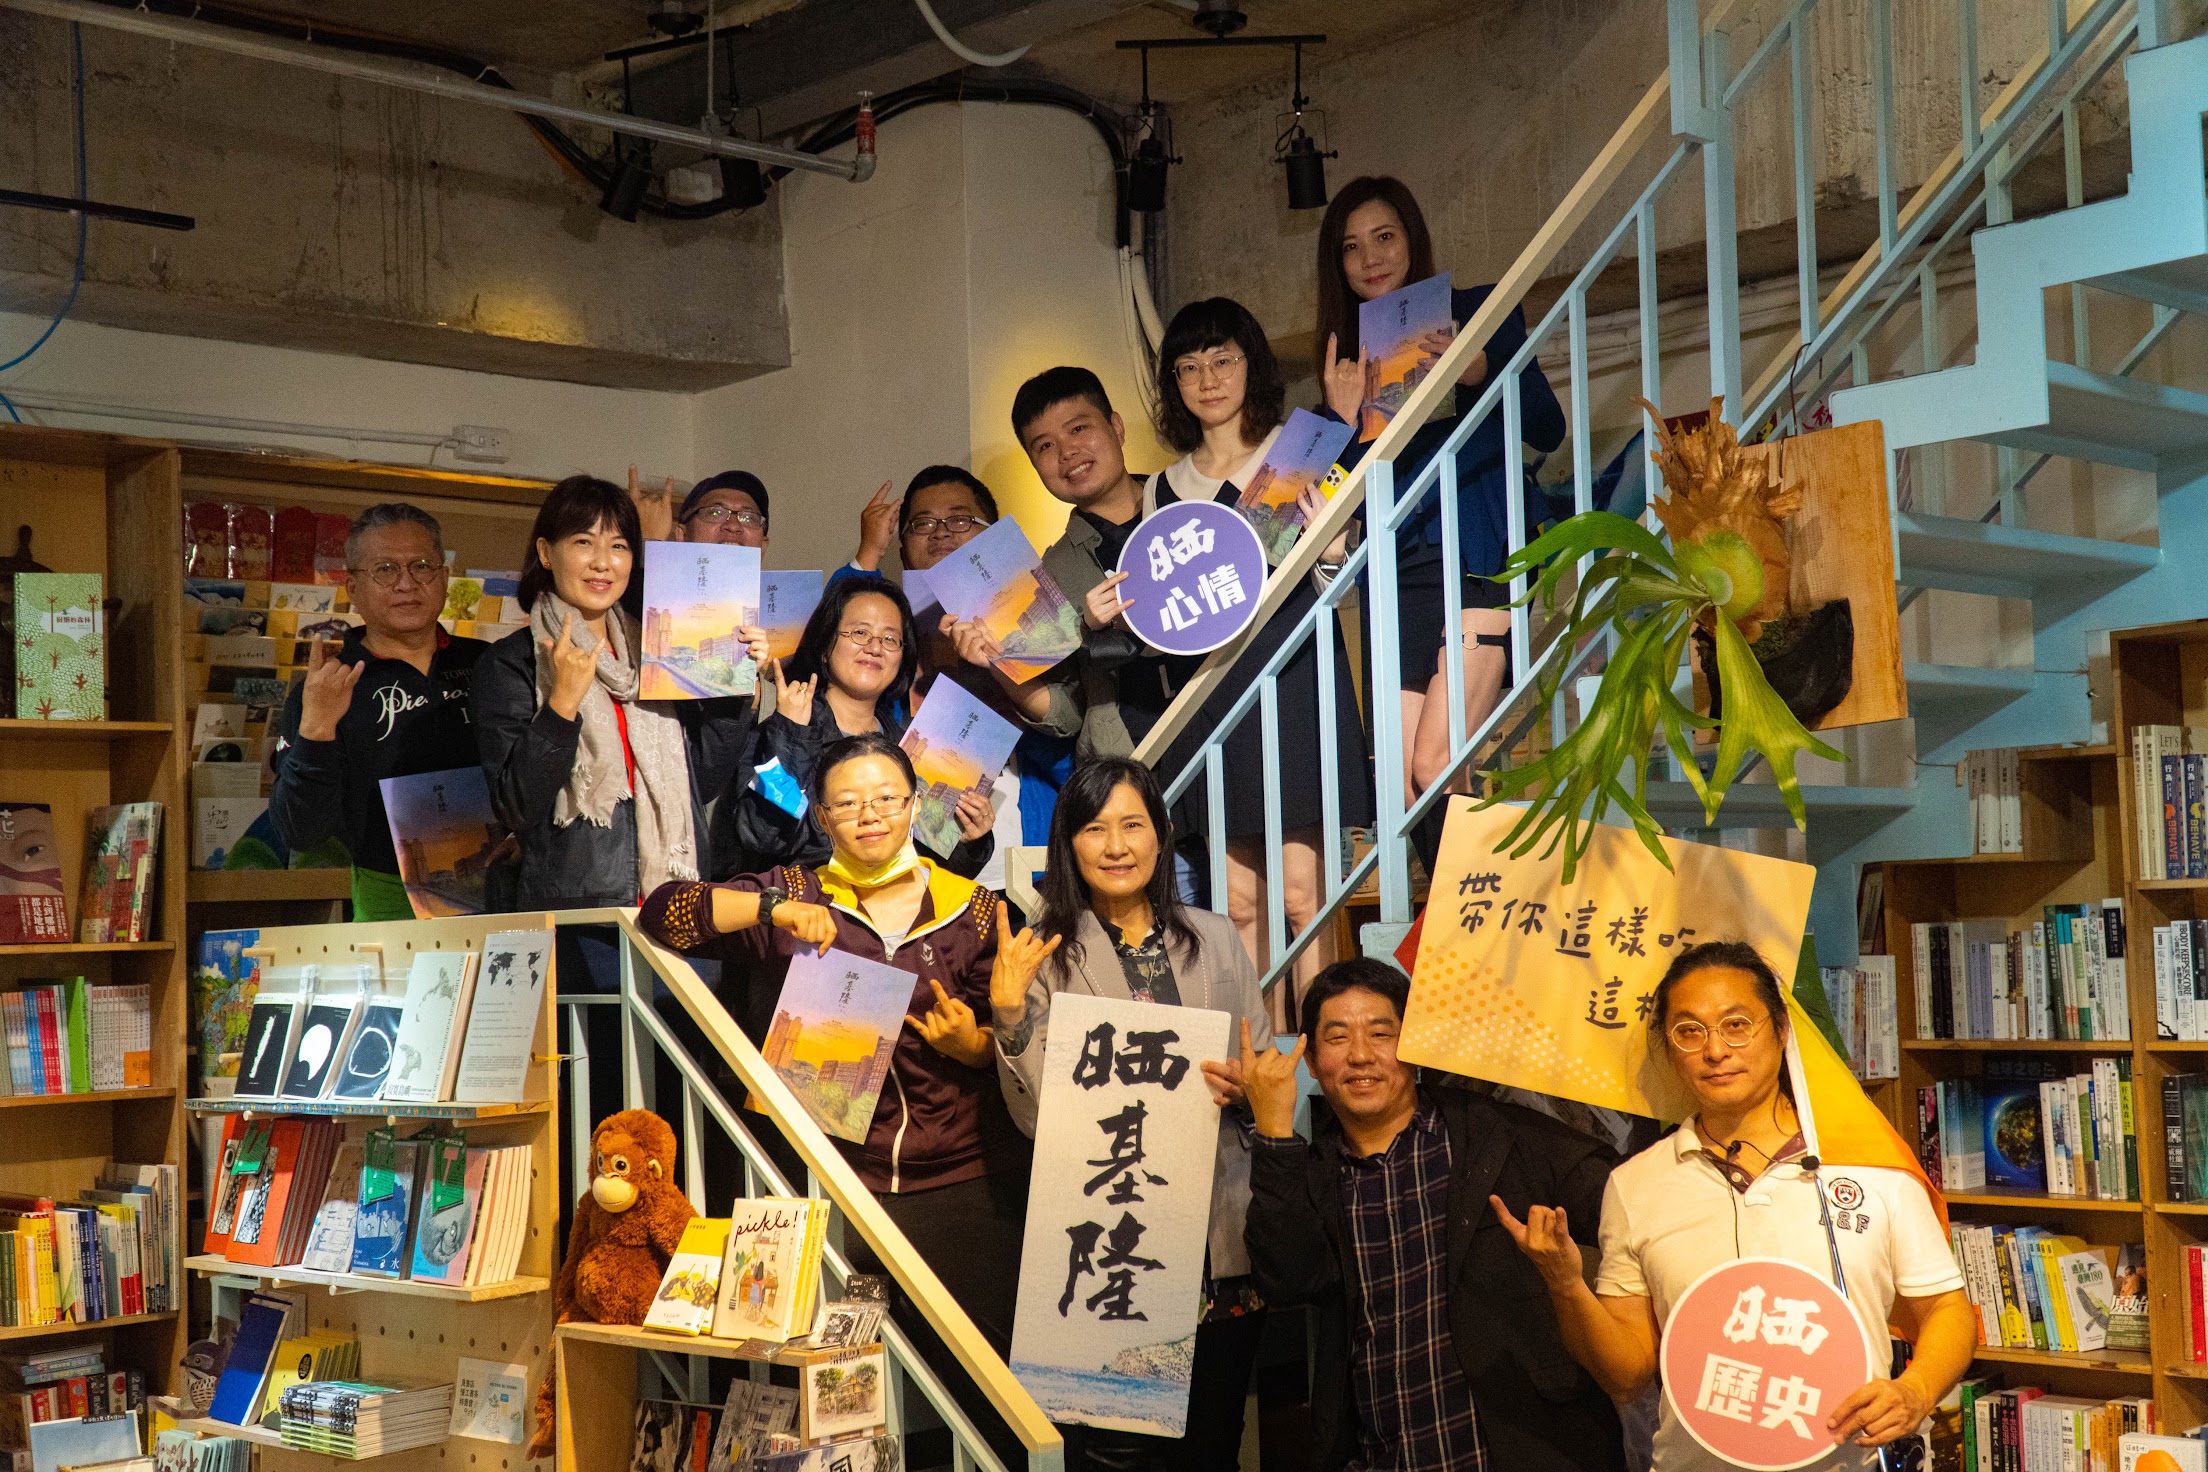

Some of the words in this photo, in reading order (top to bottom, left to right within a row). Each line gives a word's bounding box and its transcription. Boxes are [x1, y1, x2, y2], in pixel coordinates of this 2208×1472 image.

[1147, 517, 1216, 582] 晒
[1159, 563, 1247, 633] 心情
[2168, 819, 2178, 860] BEHAVE
[2190, 818, 2201, 860] BEHAVE
[1058, 1022, 1191, 1323] 晒基隆
[734, 1209, 798, 1248] pickle!
[390, 1257, 400, 1270] 水
[1722, 1284, 1830, 1356] 晒
[1694, 1352, 1822, 1441] 歷史
